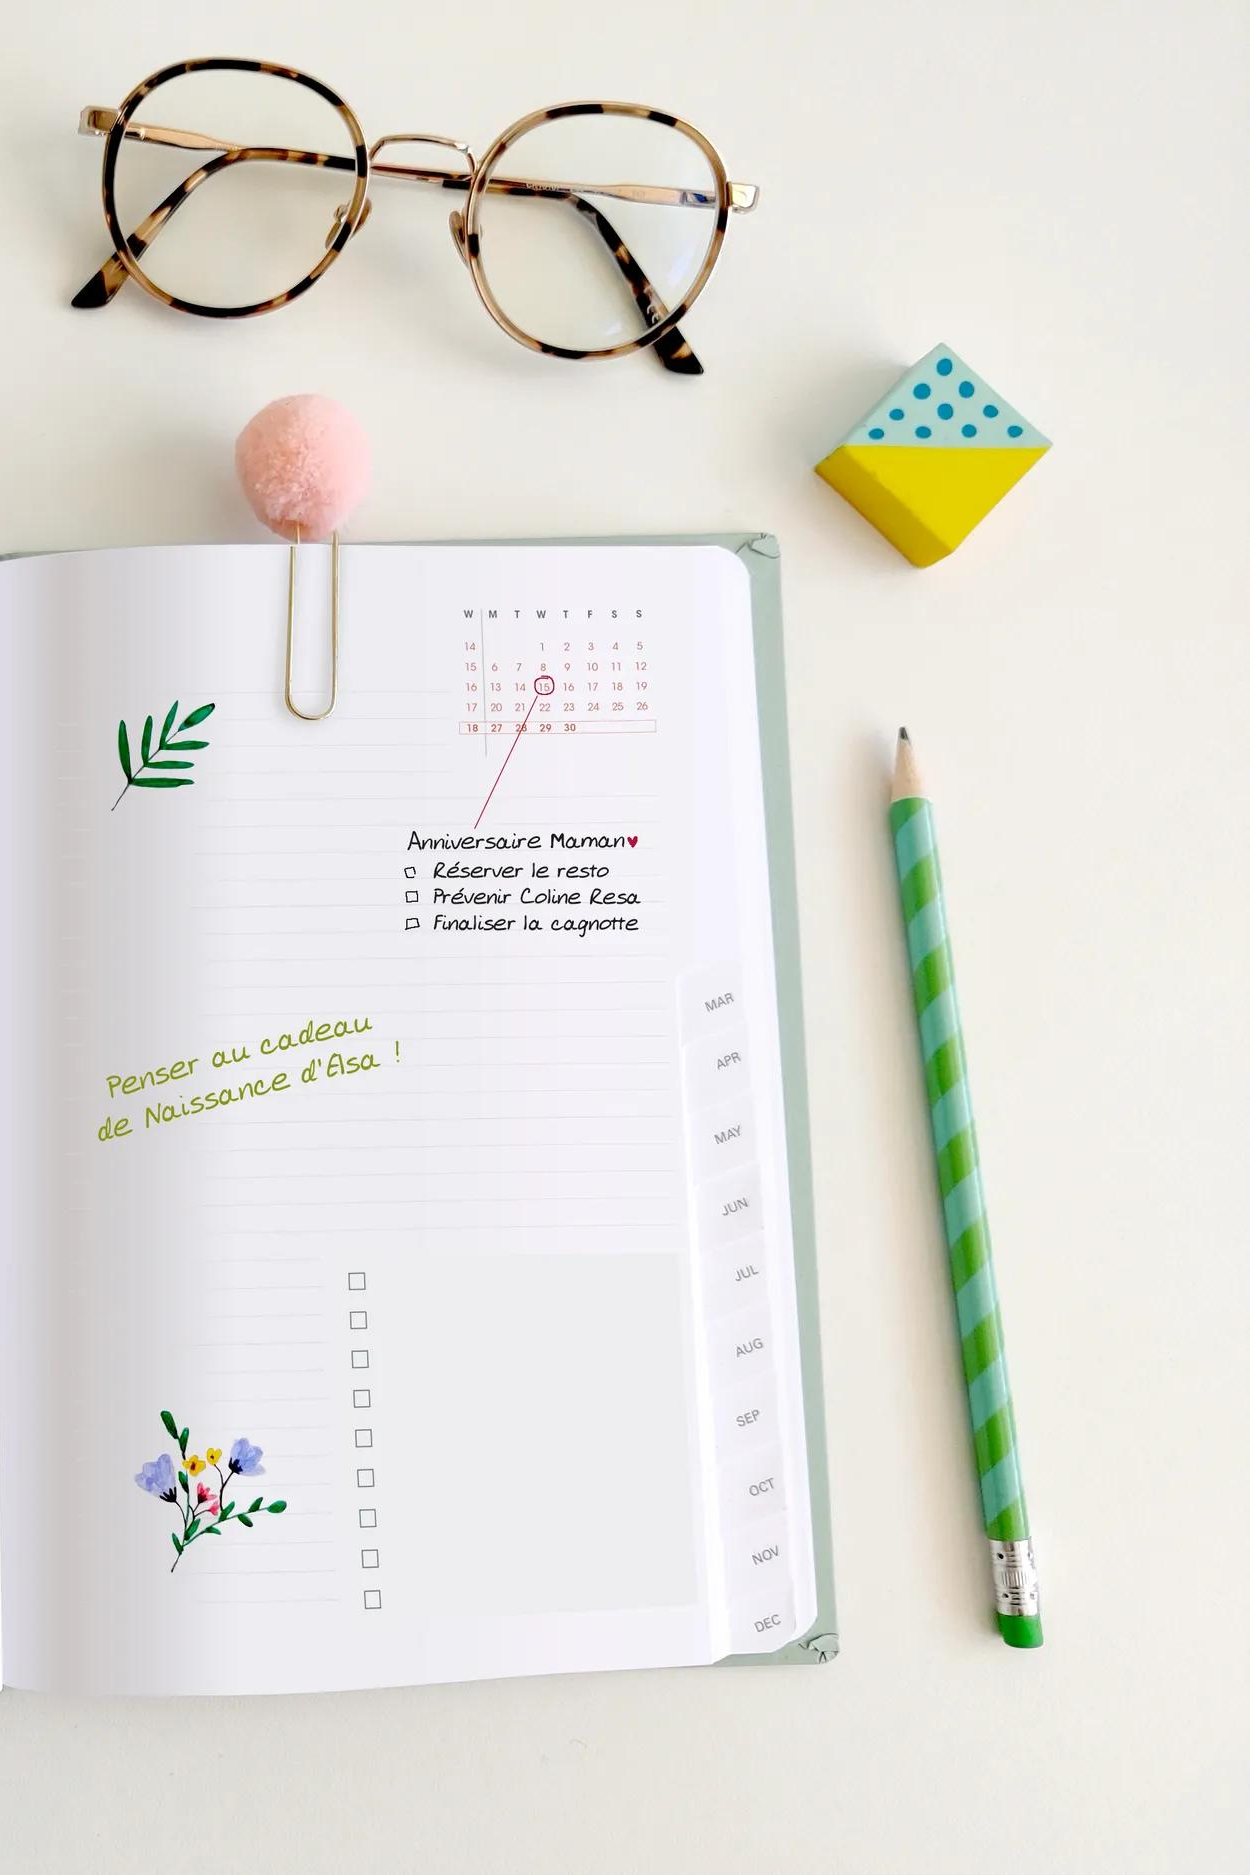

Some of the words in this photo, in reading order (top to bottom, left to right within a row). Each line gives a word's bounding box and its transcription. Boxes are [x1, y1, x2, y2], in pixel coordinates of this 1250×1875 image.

[464, 642, 476, 652] 14
[465, 662, 477, 672] 15
[587, 662, 599, 671] 10
[611, 662, 621, 671] 11
[635, 662, 647, 671] 12
[466, 683, 478, 692] 16
[490, 683, 502, 692] 13
[515, 683, 526, 692] 14
[539, 683, 550, 692] 15
[563, 683, 575, 692] 16
[587, 682, 598, 691] 17
[612, 682, 623, 691] 18
[636, 681, 648, 691] 19
[466, 703, 477, 712] 17
[490, 703, 502, 712] 20
[515, 703, 525, 712] 21
[539, 703, 551, 712] 22
[563, 703, 575, 711] 23
[587, 703, 599, 711] 24
[612, 702, 624, 711] 25
[636, 702, 648, 711] 26
[466, 724, 478, 732] 18
[491, 724, 502, 732] 27
[515, 724, 528, 732] 28
[540, 724, 552, 732] 29
[564, 723, 576, 732] 30
[407, 831, 542, 851] Anniversaire
[550, 833, 625, 849] Maman
[433, 861, 524, 879] Réserver
[531, 863, 550, 879] le
[557, 864, 610, 878] resto
[433, 887, 512, 905] Prévenir
[520, 888, 582, 905] Coline
[589, 888, 641, 905] Resa
[433, 914, 516, 931] Finaliser
[524, 915, 543, 930] la
[550, 915, 639, 938] cagnotte
[704, 992, 735, 1013] MAR
[106, 1058, 199, 1099] Penser
[211, 1046, 251, 1068] au
[260, 1016, 373, 1055] cadeau
[716, 1051, 742, 1070] APR
[97, 1116, 133, 1142] de
[145, 1072, 291, 1128] Naissance
[714, 1125, 743, 1145] MAY
[721, 1197, 749, 1217] JUN
[734, 1263, 759, 1283] JUL
[735, 1337, 764, 1359] AUG
[736, 1408, 761, 1428] SEP
[749, 1477, 775, 1497] OCT
[751, 1545, 781, 1566] NOV
[754, 1613, 782, 1633] DEC
